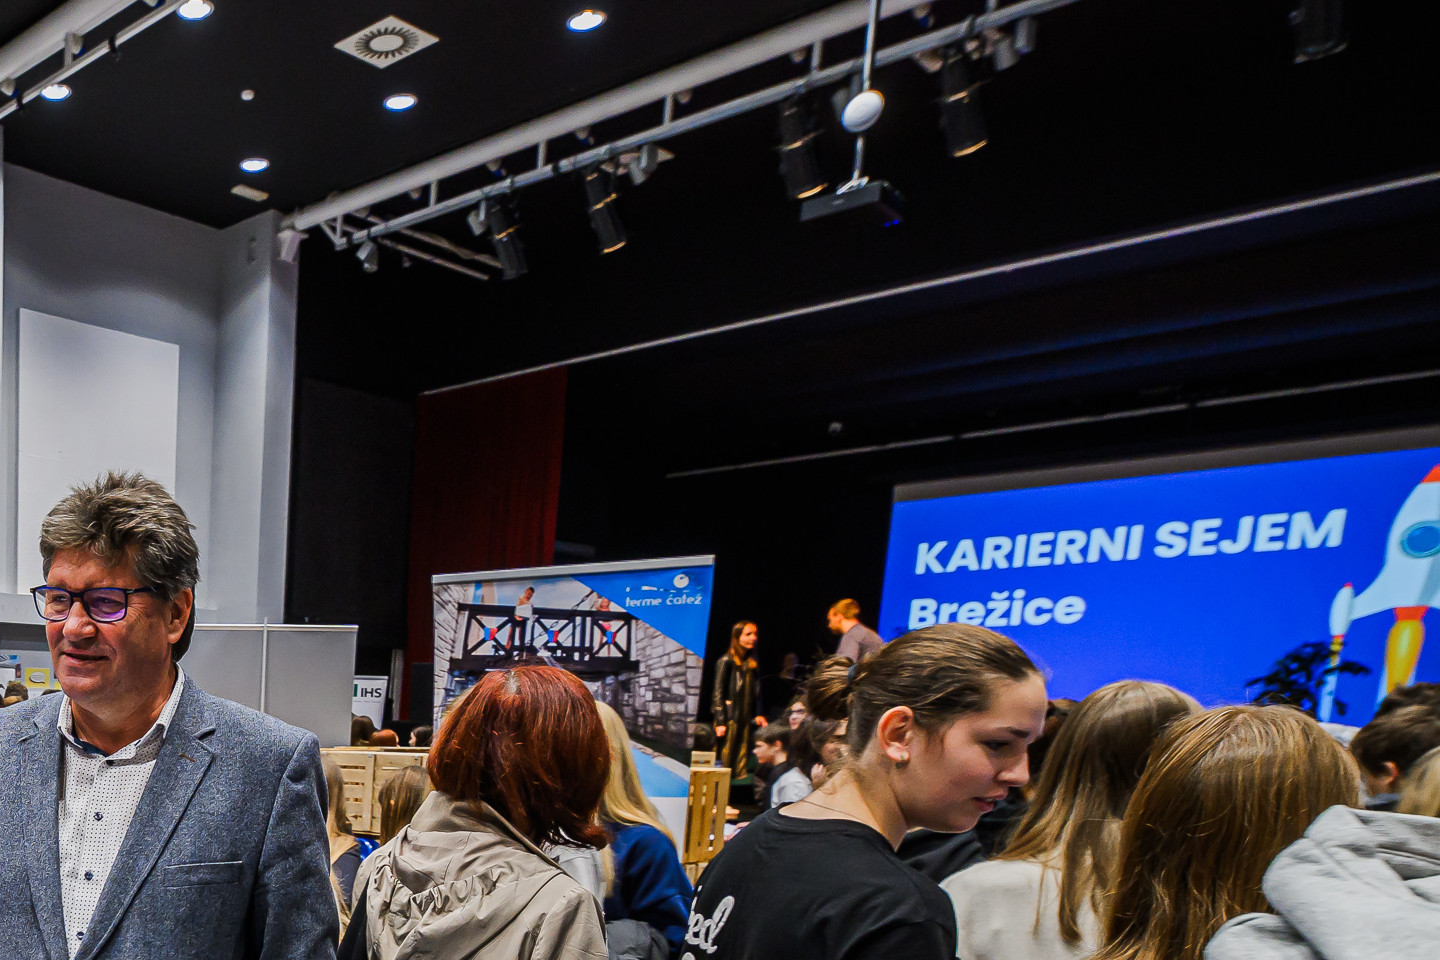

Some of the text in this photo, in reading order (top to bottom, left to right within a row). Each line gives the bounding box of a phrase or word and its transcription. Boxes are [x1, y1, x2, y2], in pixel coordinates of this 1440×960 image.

[914, 508, 1348, 575] KARIERNI SEJEM
[625, 597, 663, 608] terme
[908, 588, 1087, 630] Brežice
[360, 687, 383, 698] IHS
